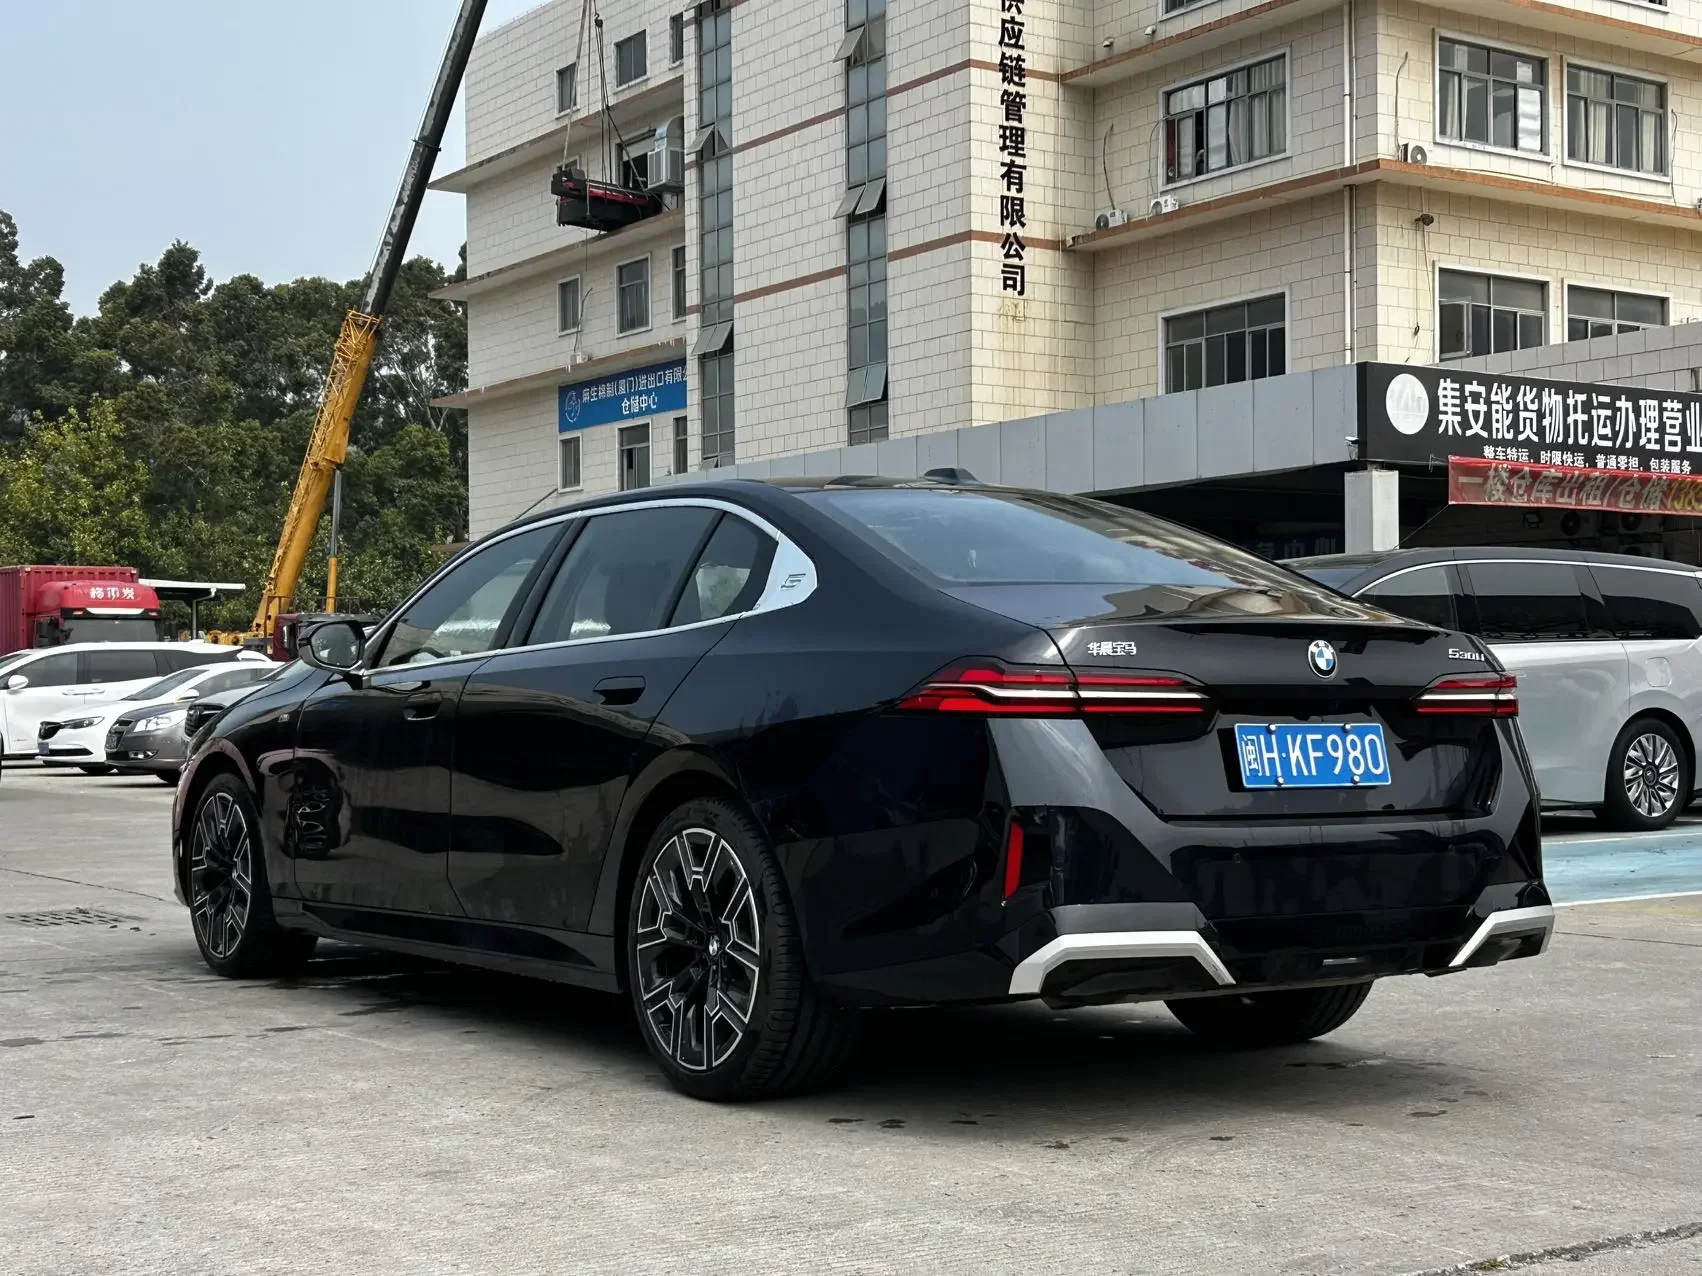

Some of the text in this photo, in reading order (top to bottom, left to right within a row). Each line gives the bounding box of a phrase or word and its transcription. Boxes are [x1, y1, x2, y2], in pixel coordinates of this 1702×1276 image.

[621, 391, 658, 415] 仓储中心
[1437, 378, 1702, 453] 集安能货物托运办理营业
[1087, 641, 1137, 656] 华晨宝马
